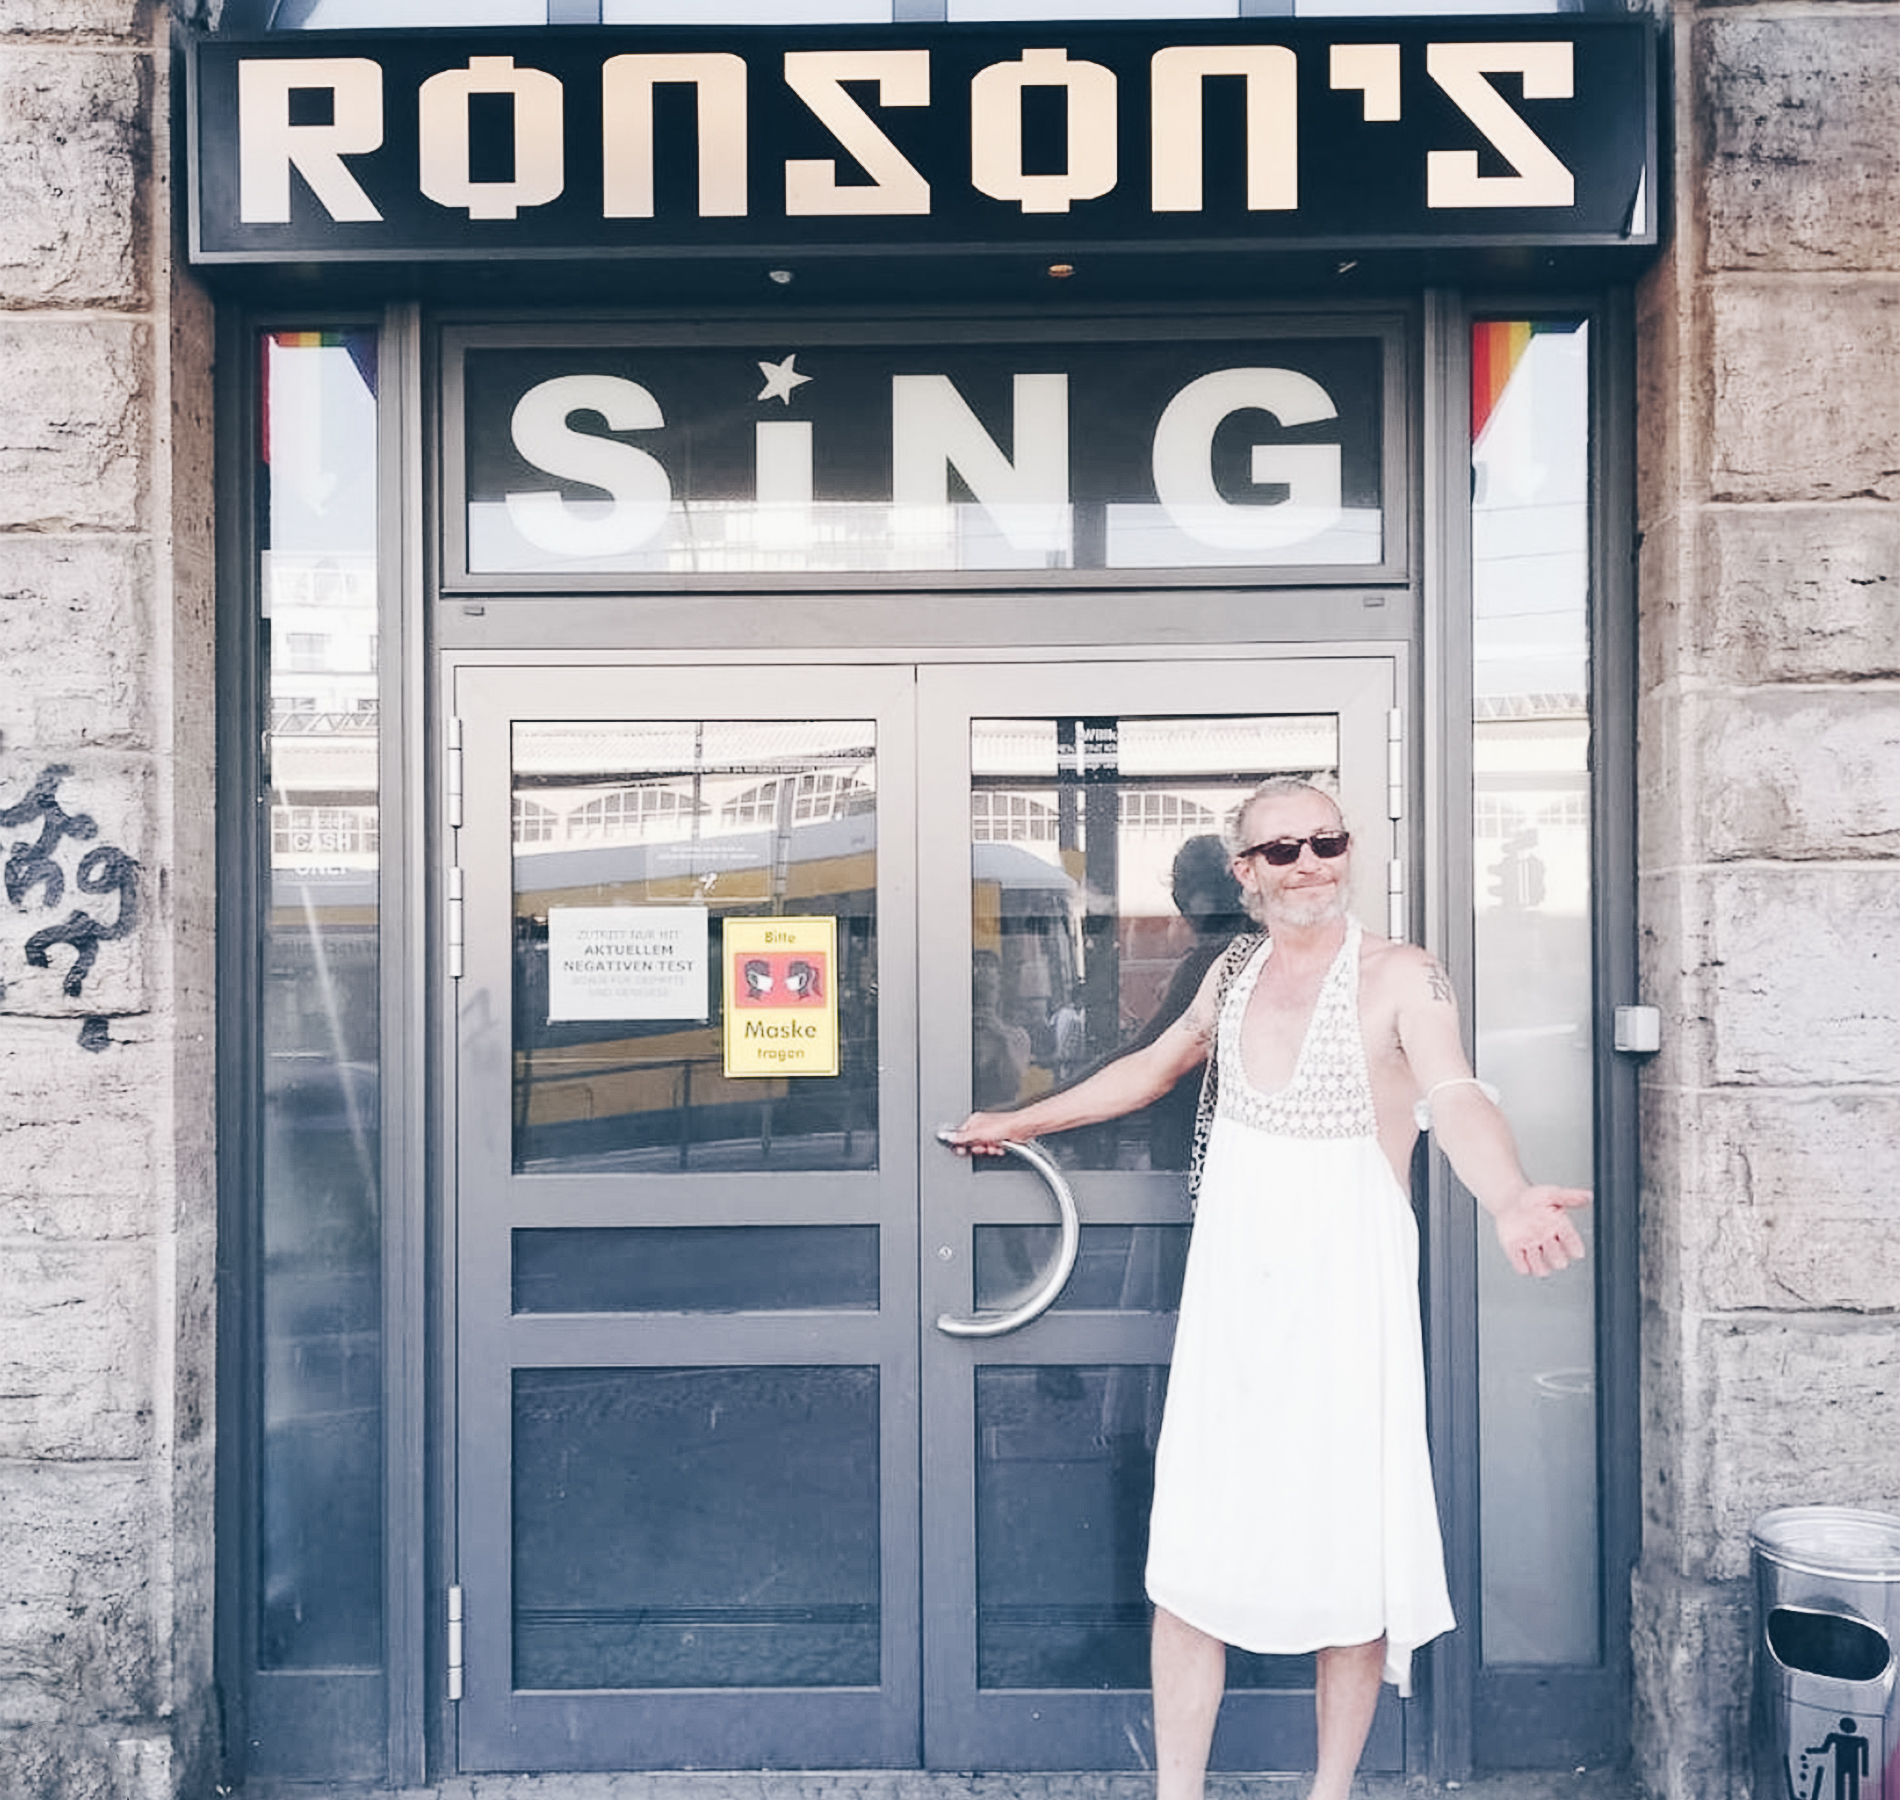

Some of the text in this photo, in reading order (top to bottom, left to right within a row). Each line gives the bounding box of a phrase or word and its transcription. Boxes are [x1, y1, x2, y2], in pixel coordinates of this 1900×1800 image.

[237, 41, 1576, 225] RONSON'S
[764, 931, 797, 944] Bitte
[584, 944, 674, 956] AKTUELLEM
[563, 960, 695, 972] NEGATIVEN TEST
[744, 1018, 818, 1039] Maske
[756, 1047, 806, 1062] tragen
